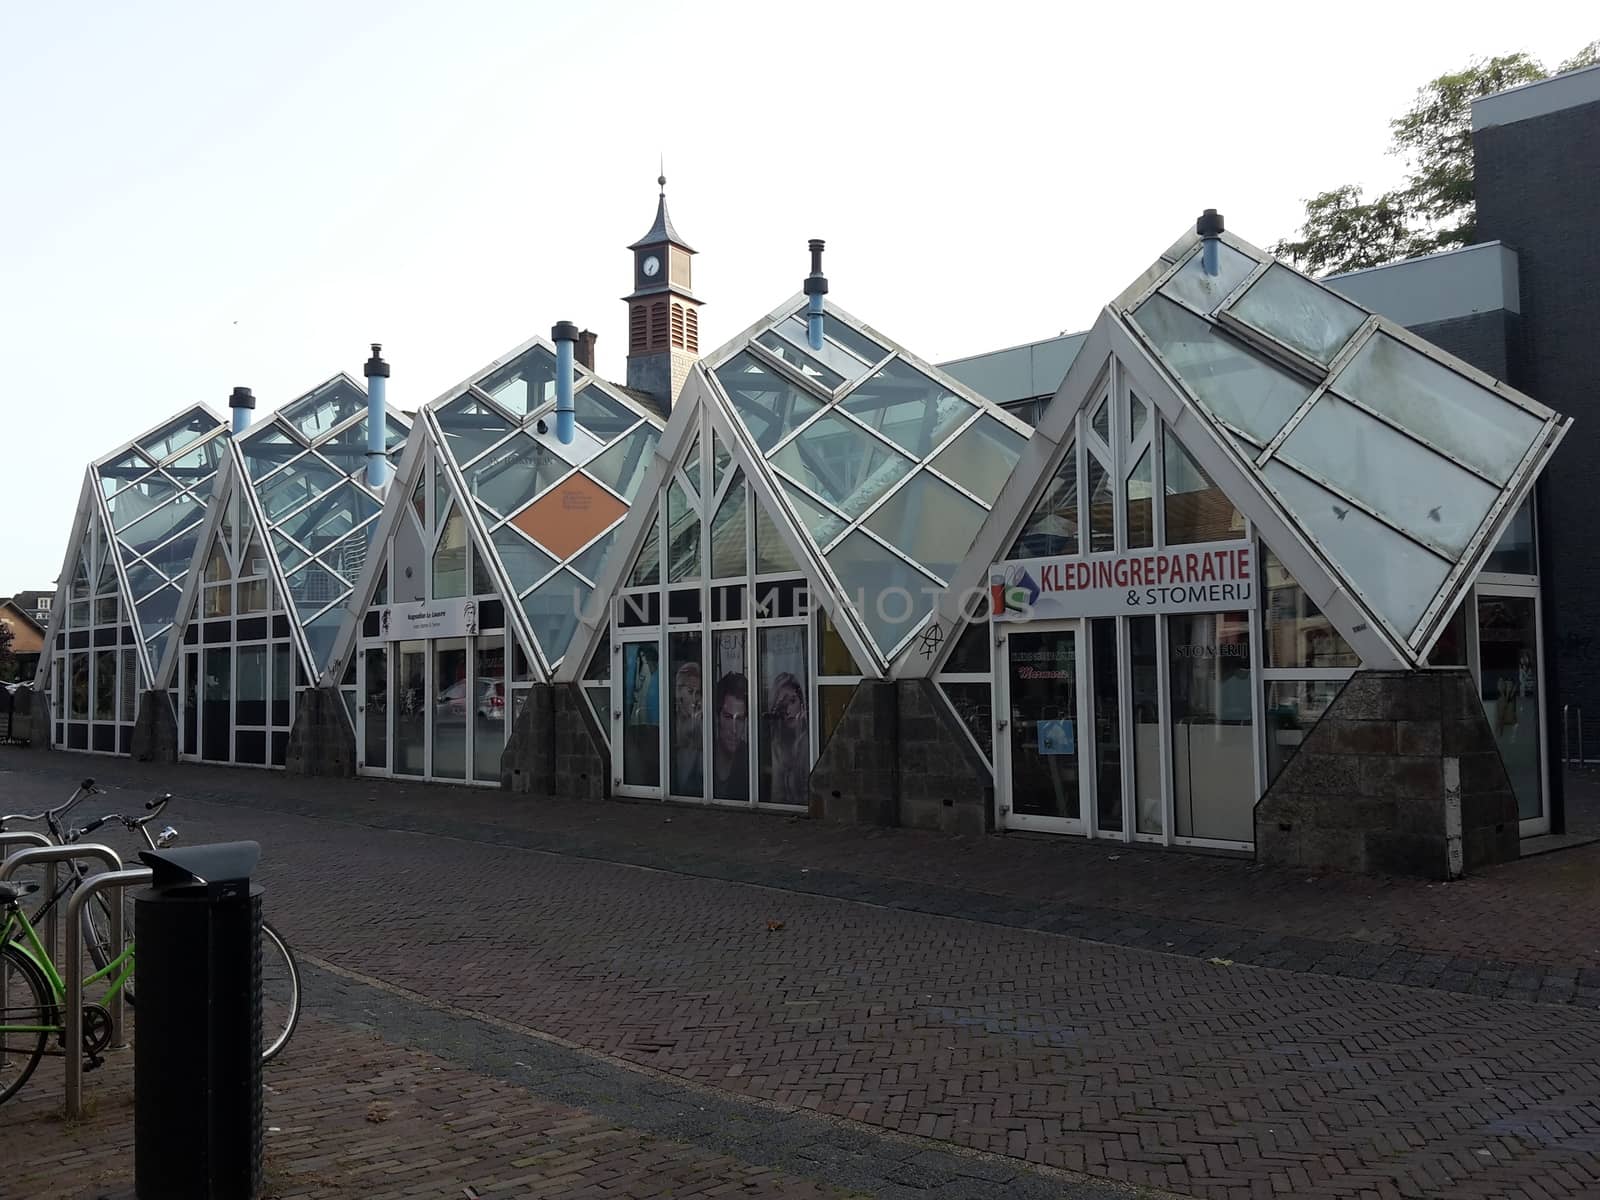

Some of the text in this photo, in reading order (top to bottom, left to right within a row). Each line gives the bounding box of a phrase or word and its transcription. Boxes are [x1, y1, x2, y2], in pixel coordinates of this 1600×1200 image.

[1041, 549, 1249, 592] KLEDINGREPARATIE
[1126, 583, 1251, 606] & STOMERIJ
